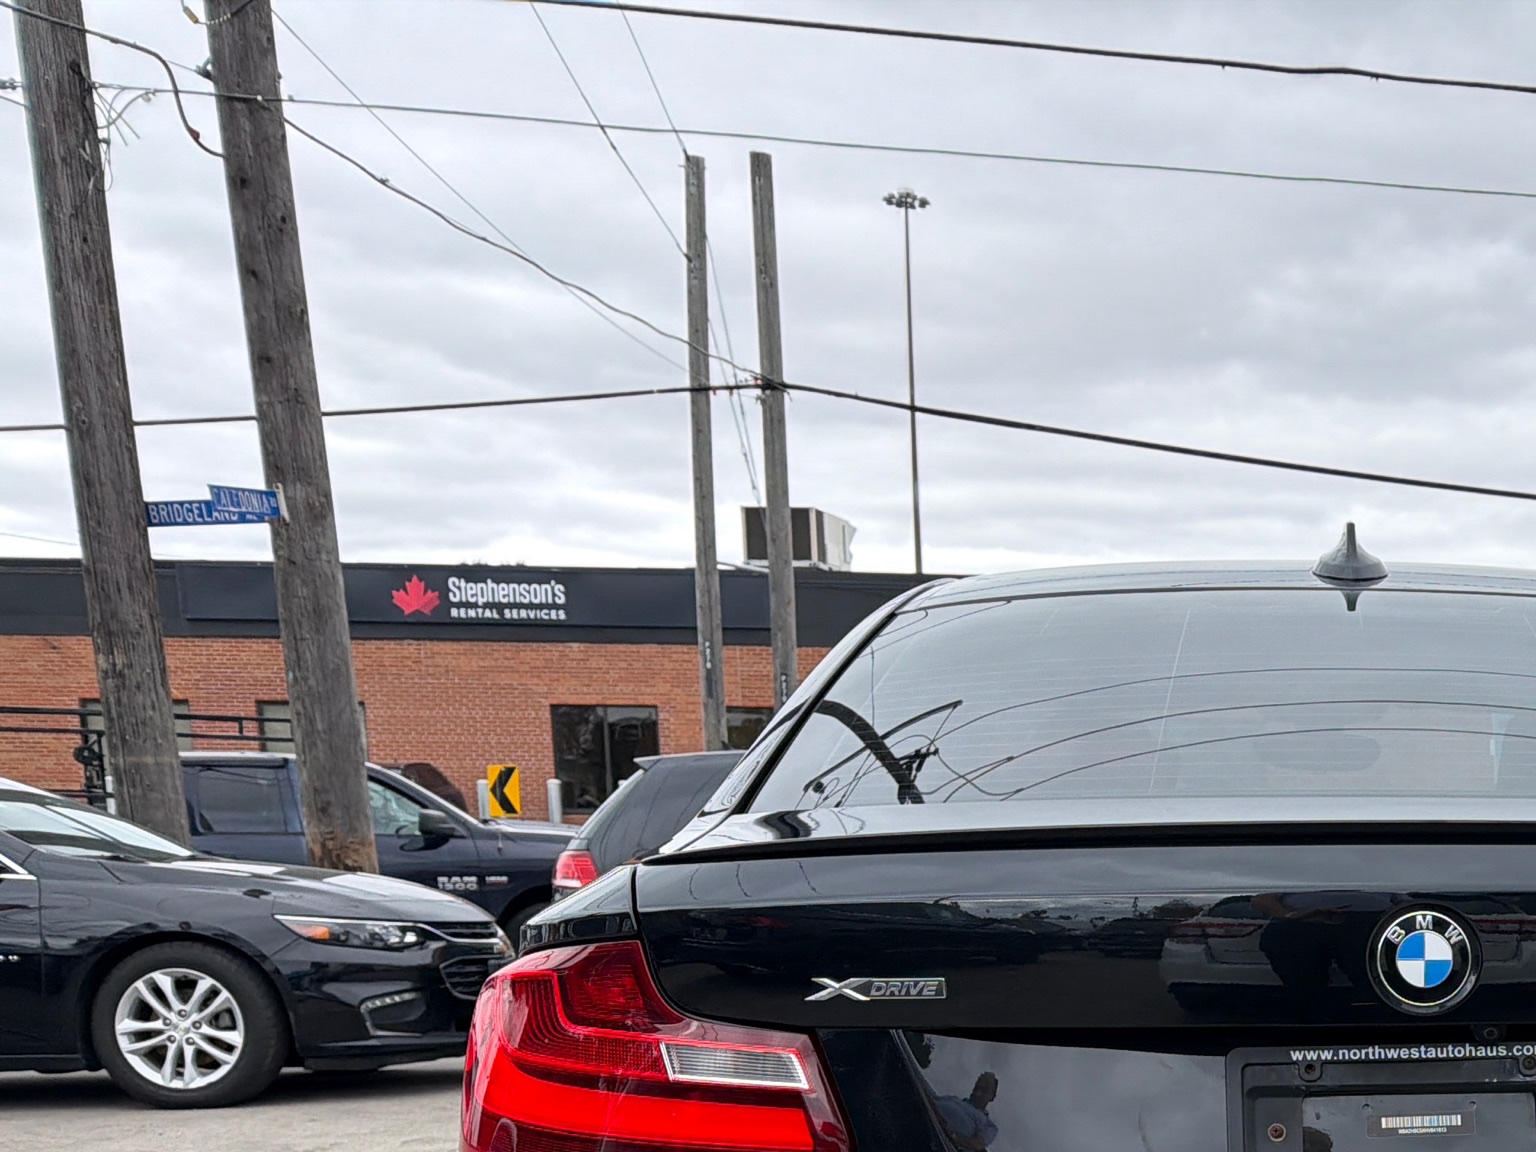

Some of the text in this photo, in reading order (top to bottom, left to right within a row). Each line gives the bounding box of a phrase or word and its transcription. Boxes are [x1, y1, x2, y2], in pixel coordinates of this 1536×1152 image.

[213, 488, 271, 514] CALEDONIA
[447, 576, 567, 606] Stephenson's
[450, 607, 567, 621] RENTAL SERVICES
[1386, 914, 1464, 946] BMW
